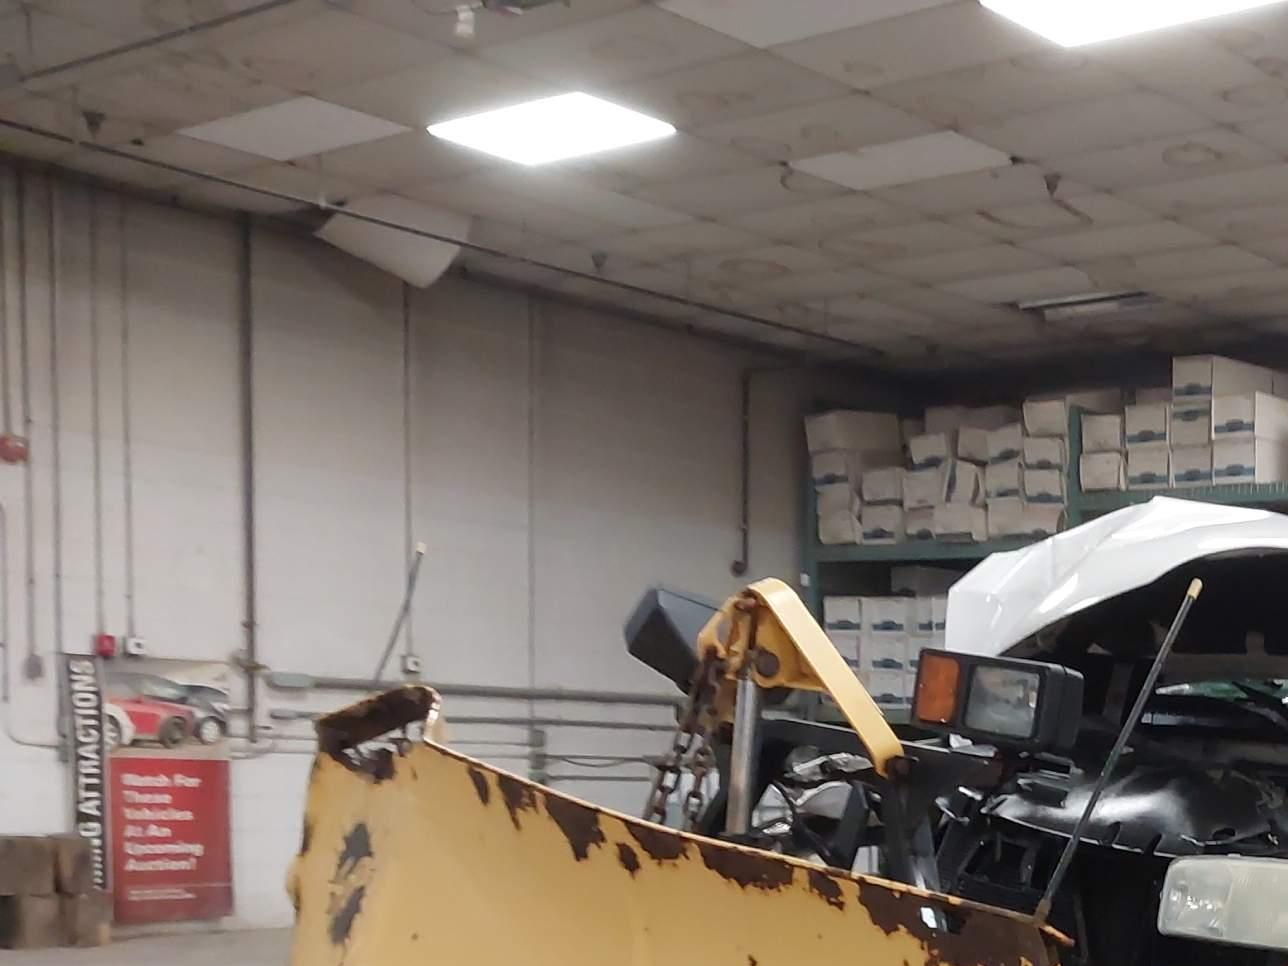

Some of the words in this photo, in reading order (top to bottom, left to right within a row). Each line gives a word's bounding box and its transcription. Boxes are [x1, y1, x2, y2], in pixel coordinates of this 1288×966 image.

[69, 659, 102, 818] ATTRACTIONS
[123, 807, 194, 820] Vehicles
[124, 841, 205, 857] Upcoming
